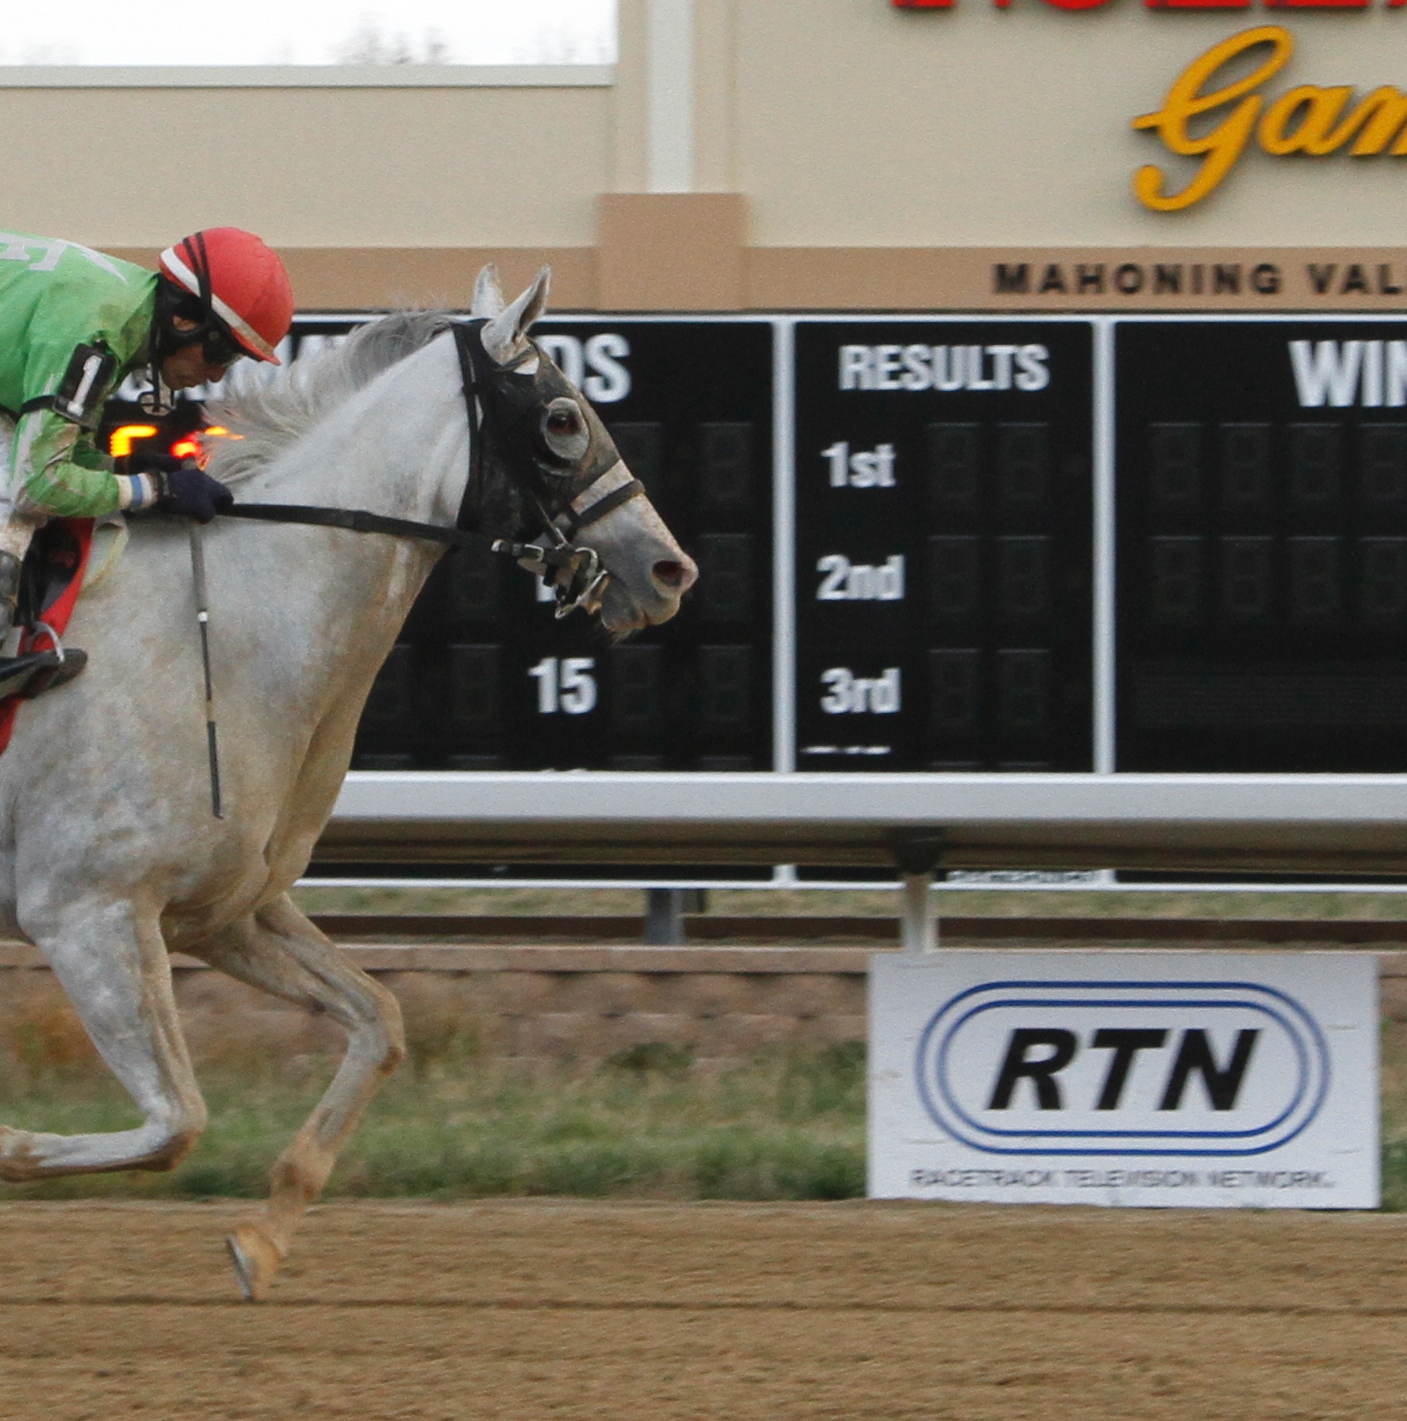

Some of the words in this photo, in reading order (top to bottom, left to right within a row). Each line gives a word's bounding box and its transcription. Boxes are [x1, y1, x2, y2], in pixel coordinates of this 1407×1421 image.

[994, 263, 1281, 295] MAHONING
[67, 354, 103, 417] 1
[839, 343, 1050, 391] RESULTS
[821, 442, 896, 488] 1st
[816, 555, 904, 601] 2nd
[528, 657, 596, 714] 15
[820, 667, 901, 714] 3rd
[985, 1028, 1264, 1111] RTN
[910, 1168, 1055, 1188] RACETRACK
[1063, 1168, 1199, 1188] TELEVISION
